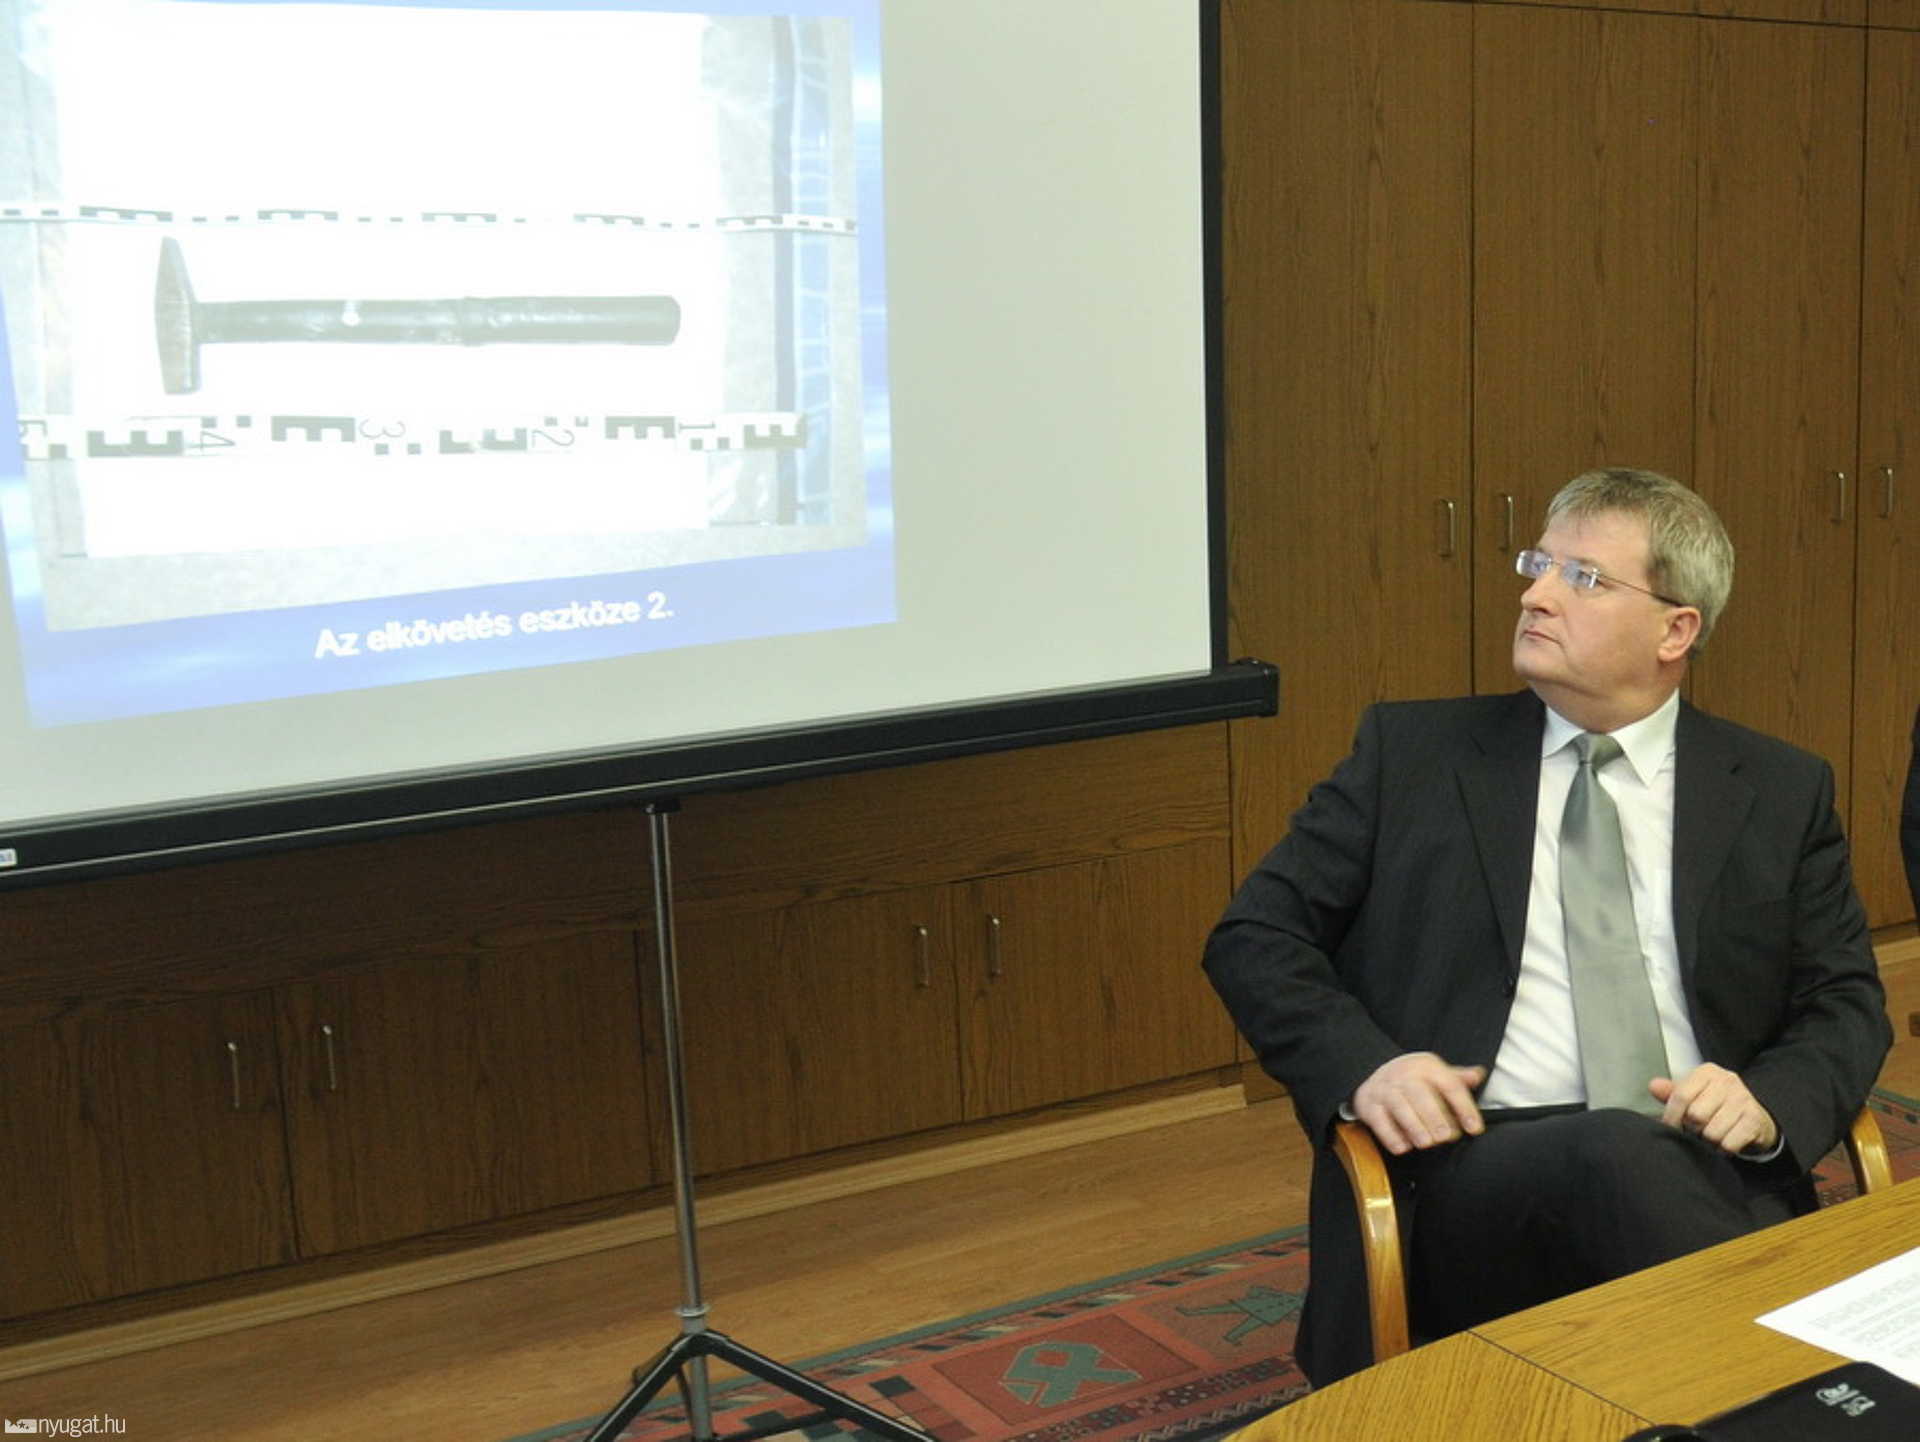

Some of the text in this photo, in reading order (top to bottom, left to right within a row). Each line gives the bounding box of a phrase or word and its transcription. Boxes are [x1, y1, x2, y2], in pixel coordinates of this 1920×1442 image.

[314, 591, 675, 659] Az elkövetés eszköze 2.
